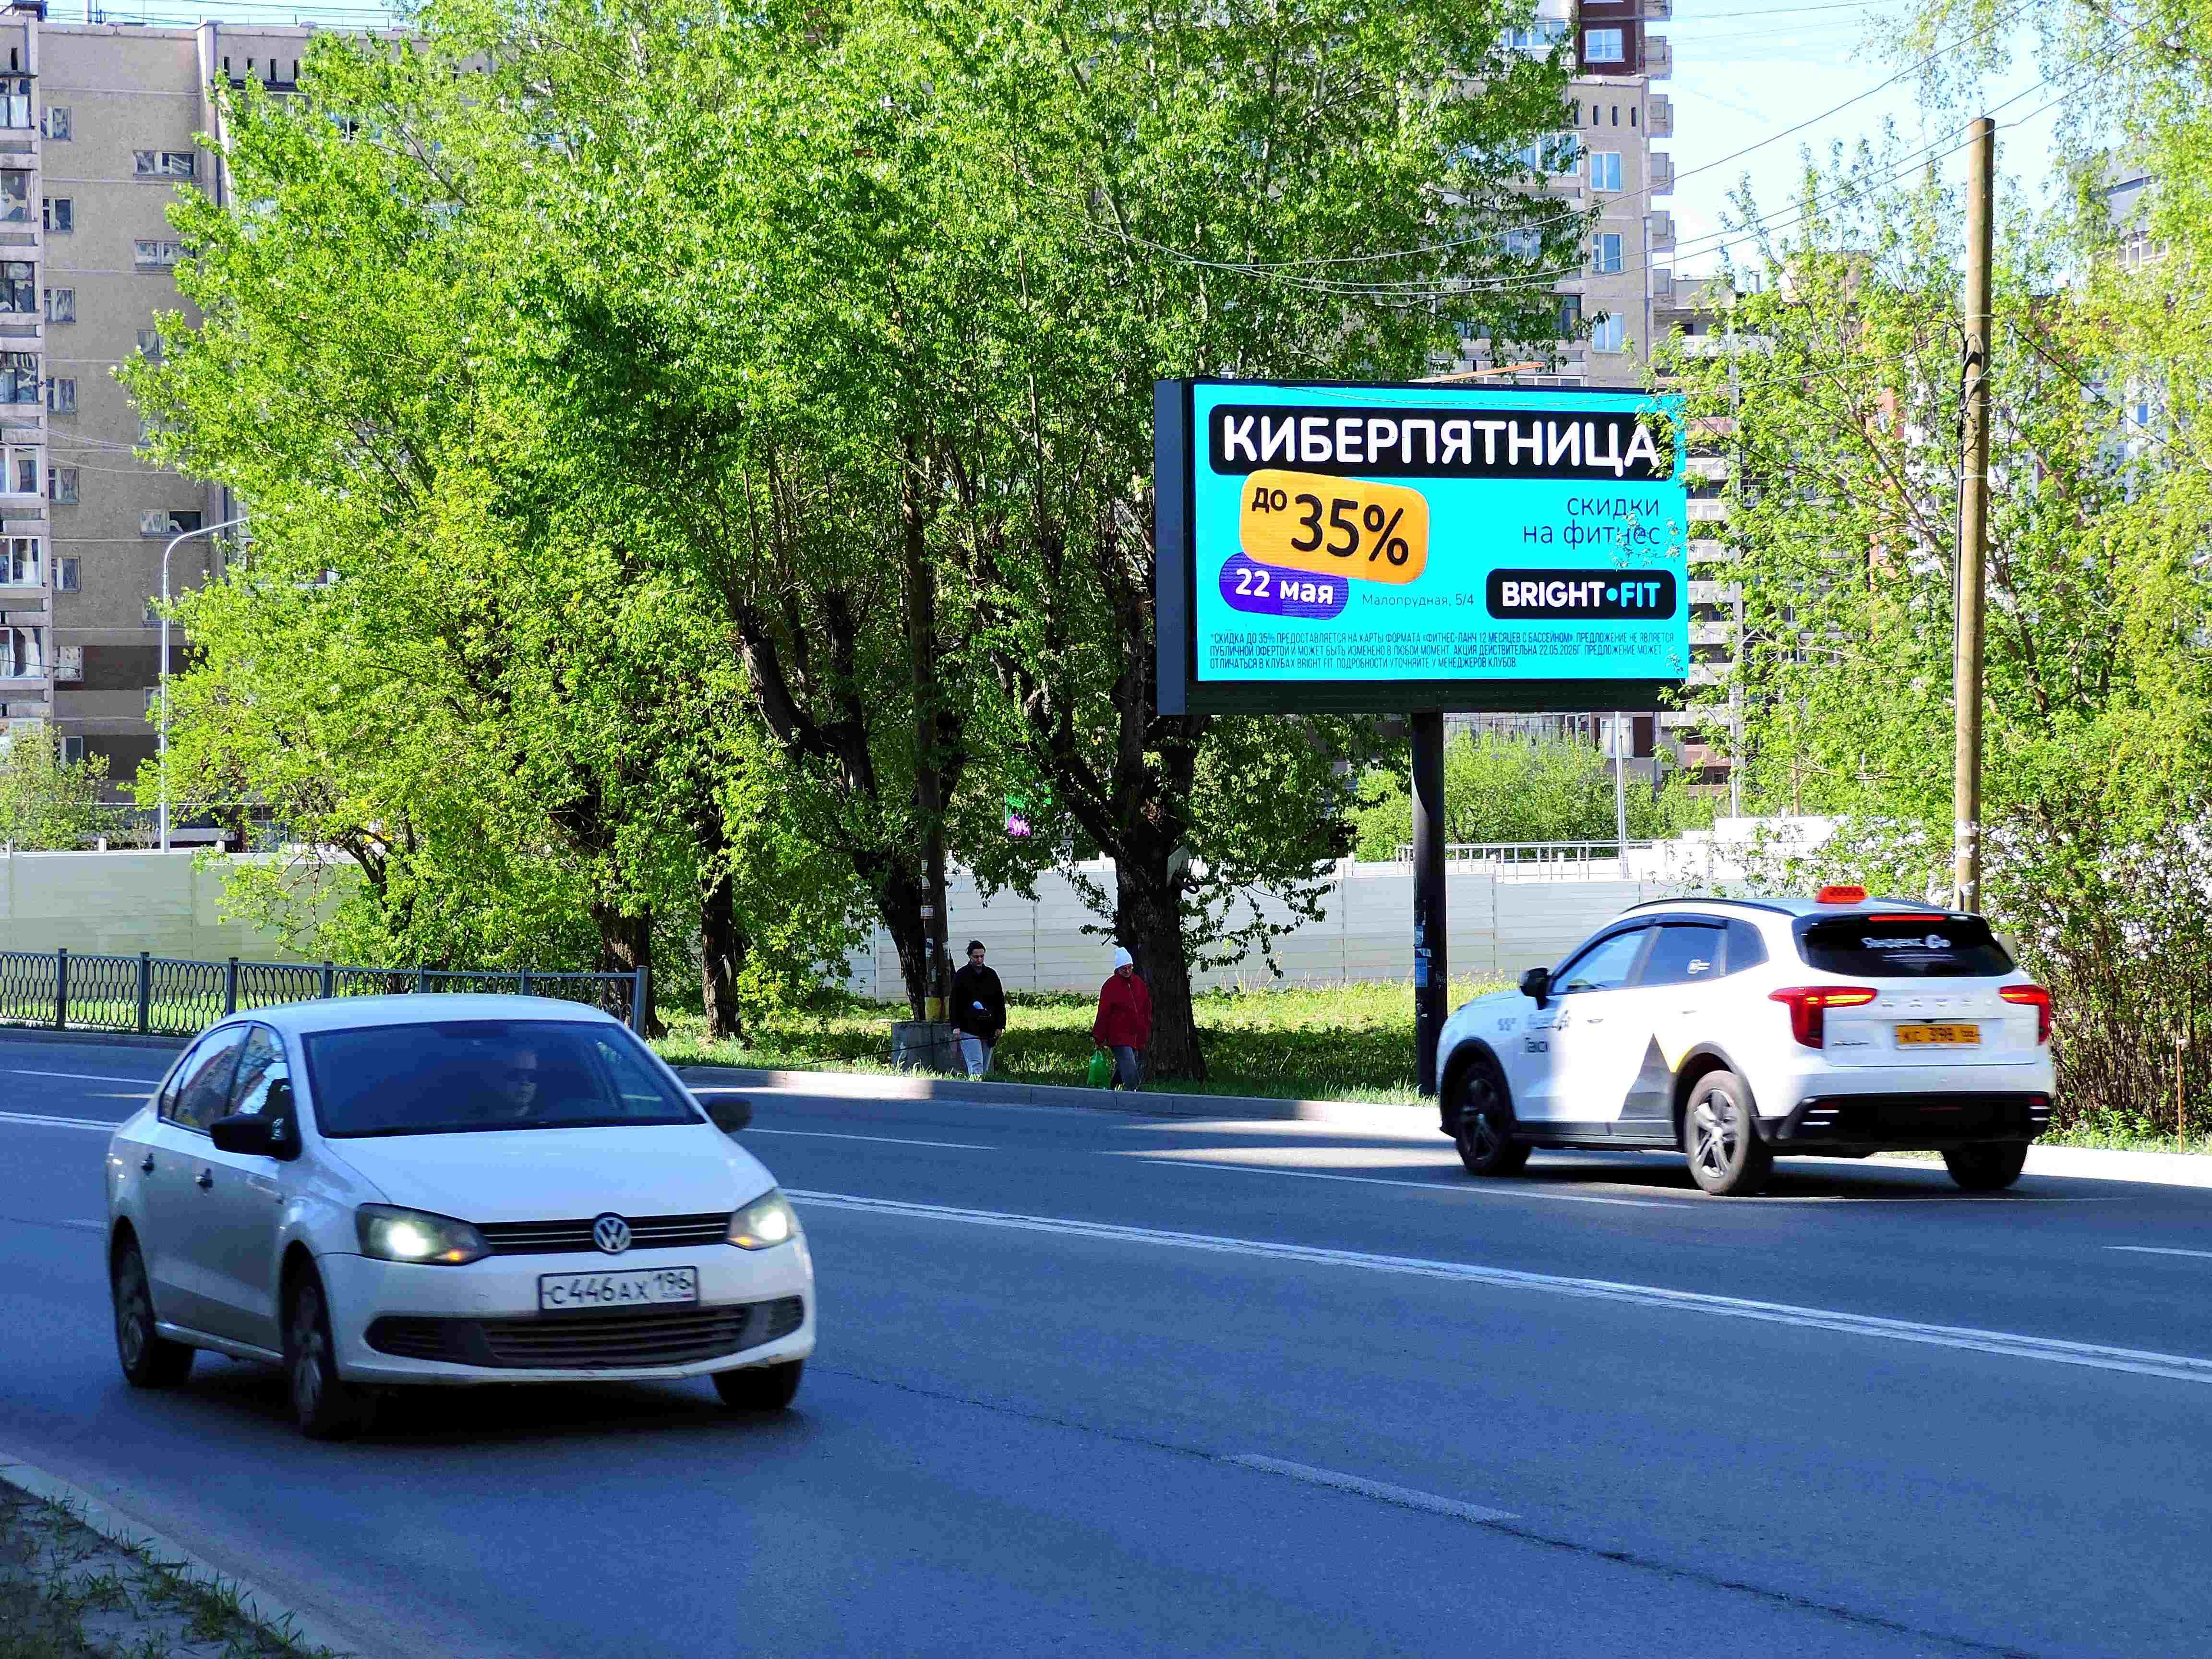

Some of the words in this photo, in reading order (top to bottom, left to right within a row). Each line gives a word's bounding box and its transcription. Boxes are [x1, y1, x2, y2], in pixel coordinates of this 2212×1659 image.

[1224, 415, 1661, 477] КИБЕРПЯТНИЦА
[1567, 498, 1659, 520] скидки
[1251, 486, 1287, 514] до
[1290, 493, 1409, 565] 35%
[1523, 525, 1553, 544] на
[1563, 519, 1660, 550] фитнес
[1235, 568, 1271, 598] 22
[1279, 580, 1334, 605] мая
[1362, 593, 1452, 609] Малопрудная,
[1455, 593, 1474, 606] 5/4
[1247, 632, 1257, 644] ДО
[1277, 632, 1346, 644] ПРЕДОСТАВЛЯЕТСЯ
[1348, 632, 1358, 644] НА
[1360, 632, 1383, 644] КАРТЫ
[1386, 632, 1420, 644] ФОРМАТА
[1479, 632, 1487, 644] 12
[1489, 632, 1520, 644] МЕСЯЦЕВ
[1576, 632, 1627, 644] ПРЕДЛОЖЕНИЕ
[1630, 632, 1637, 644] НЕ
[1639, 632, 1674, 644] ЯВЛЯЕТСЯ
[1210, 645, 1253, 656] ПУБЛИЧНОЙ
[1256, 645, 1289, 656] ОФЕРТОЙ
[1298, 645, 1323, 656] МОЖЕТ
[1326, 645, 1345, 656] БЫТЬ
[1347, 645, 1385, 656] ИЗМЕНЕНО
[1393, 645, 1418, 656] ЛЮБОЙ
[1454, 645, 1477, 656] АКЦИЯ
[1479, 645, 1537, 656] ДЕЙСТВИТЕЛЬНА
[1585, 645, 1635, 656] ПРЕДЛОЖЕНИЕ
[1637, 645, 1662, 656] МОЖЕТ
[1210, 658, 1257, 669] ОТЛИЧАТЬСЯ
[1266, 658, 1295, 669] КЛУБАХ
[1297, 658, 1321, 669] BRIGHT
[1336, 658, 1387, 669] ПОДРОБНОСТИ
[1390, 658, 1429, 669] УТОЧНЯЙТЕ
[1439, 658, 1486, 669] МЕНЕДЖЕРОВ
